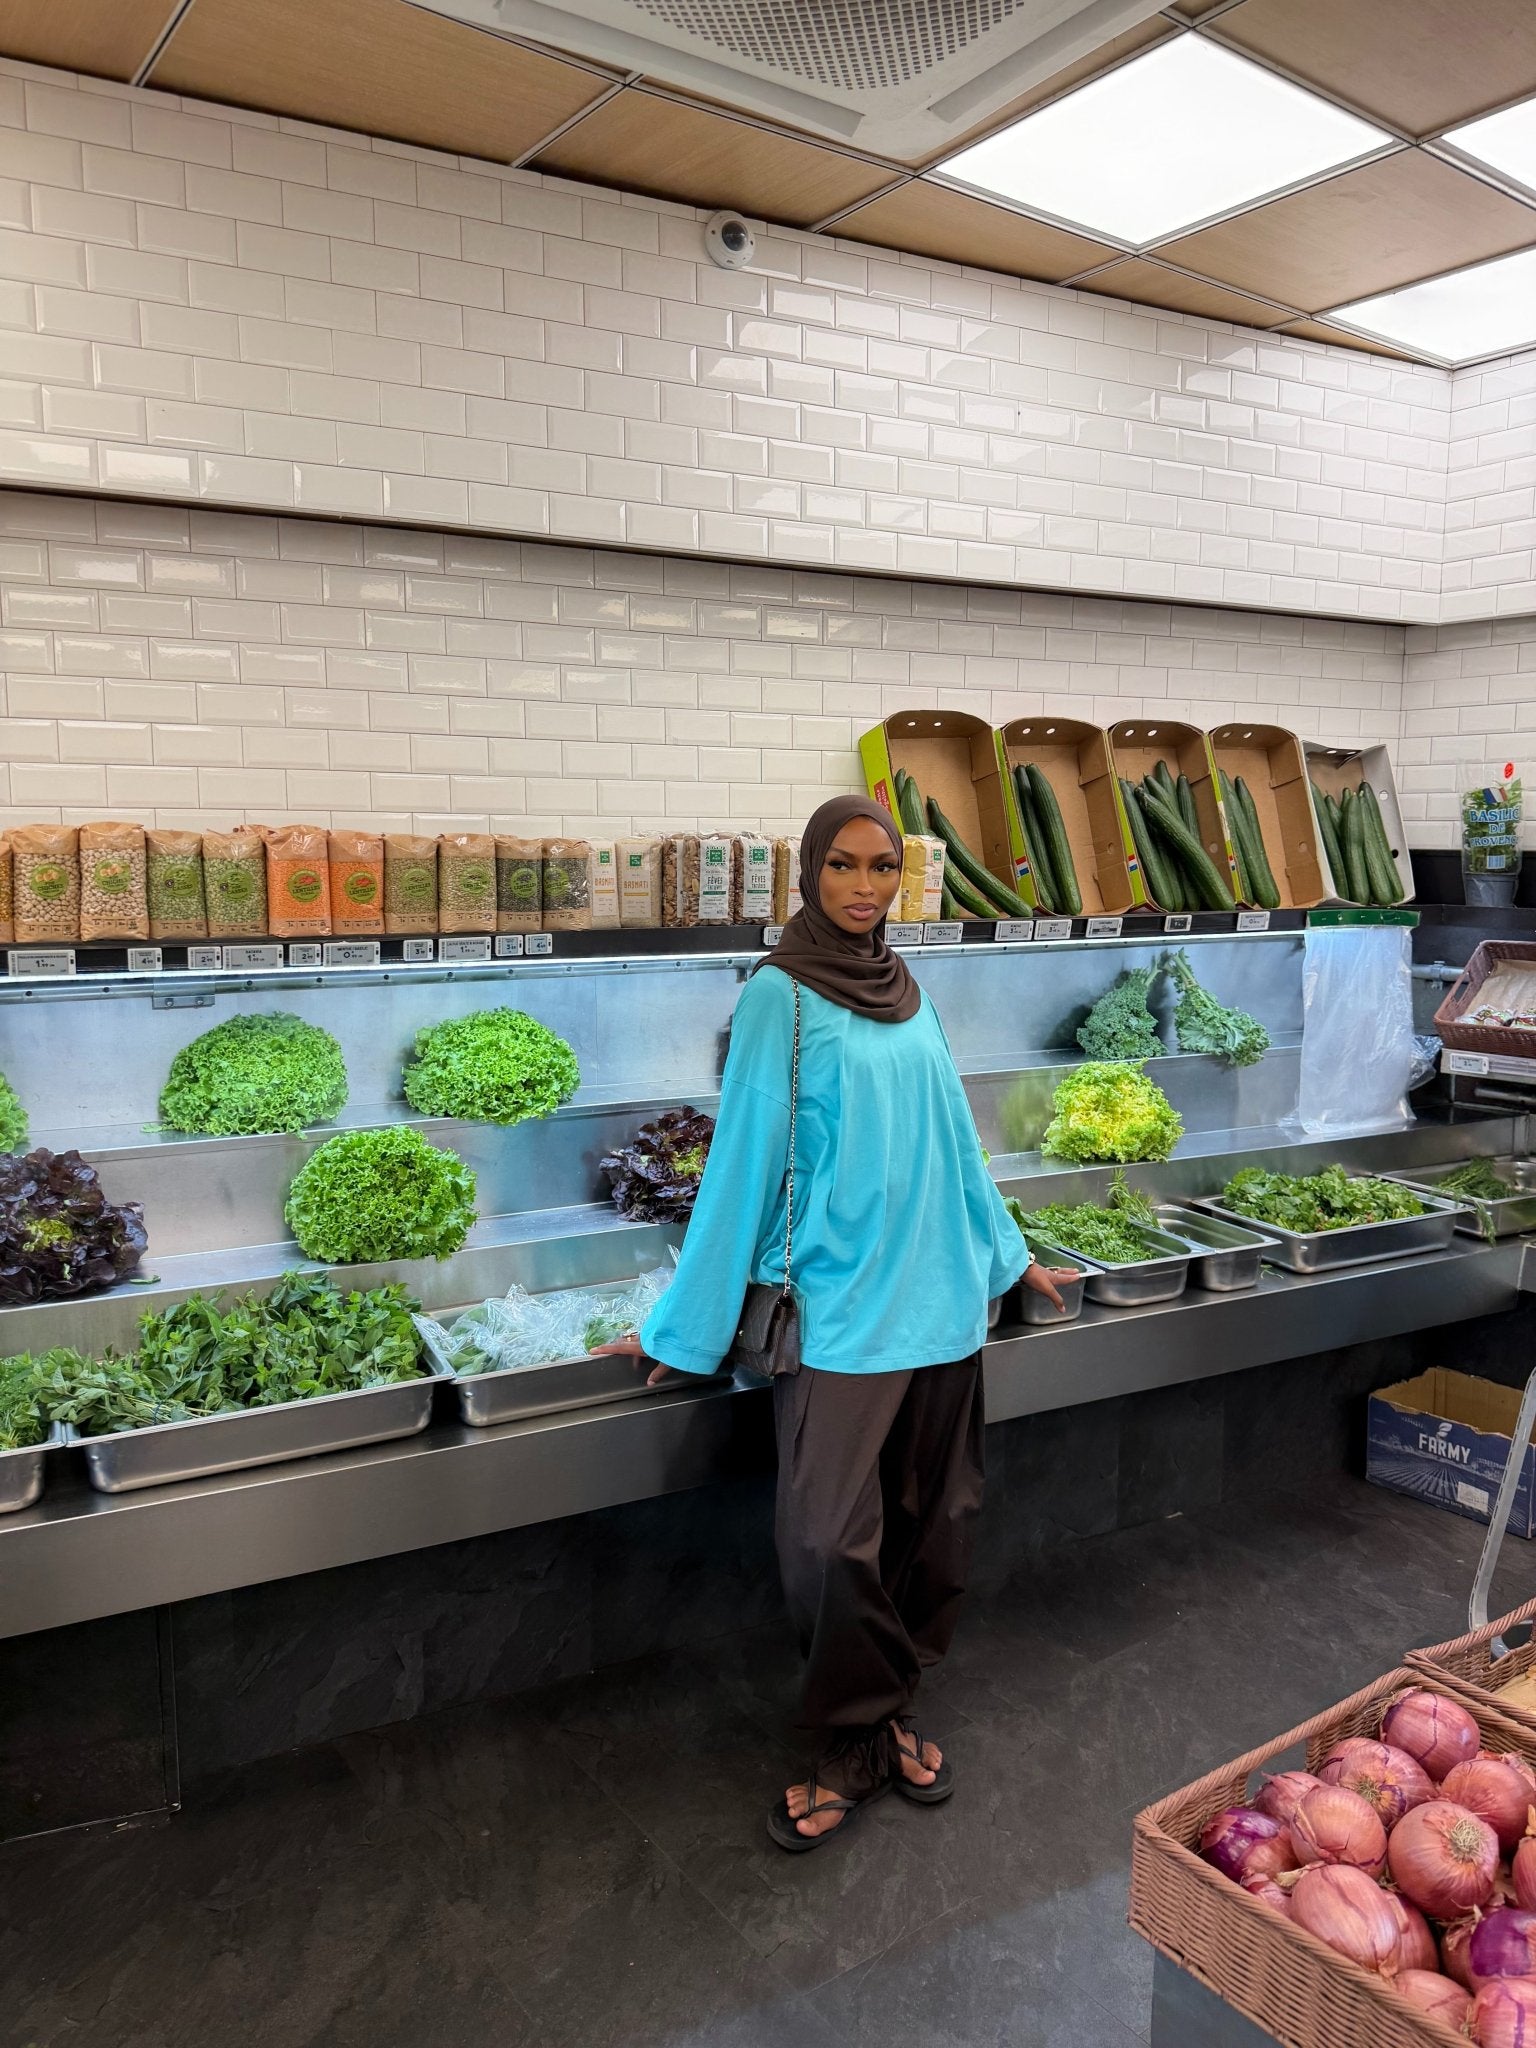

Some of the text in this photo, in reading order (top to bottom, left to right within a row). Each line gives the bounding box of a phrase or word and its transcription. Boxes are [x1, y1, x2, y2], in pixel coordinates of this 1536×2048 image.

[1470, 807, 1519, 822] BASILIC
[1470, 836, 1518, 847] PROVENC
[292, 885, 321, 895] LENTILLES
[623, 880, 649, 890] BASMATI
[349, 886, 376, 896] LENTILLES
[1418, 1433, 1471, 1464] FARMY
